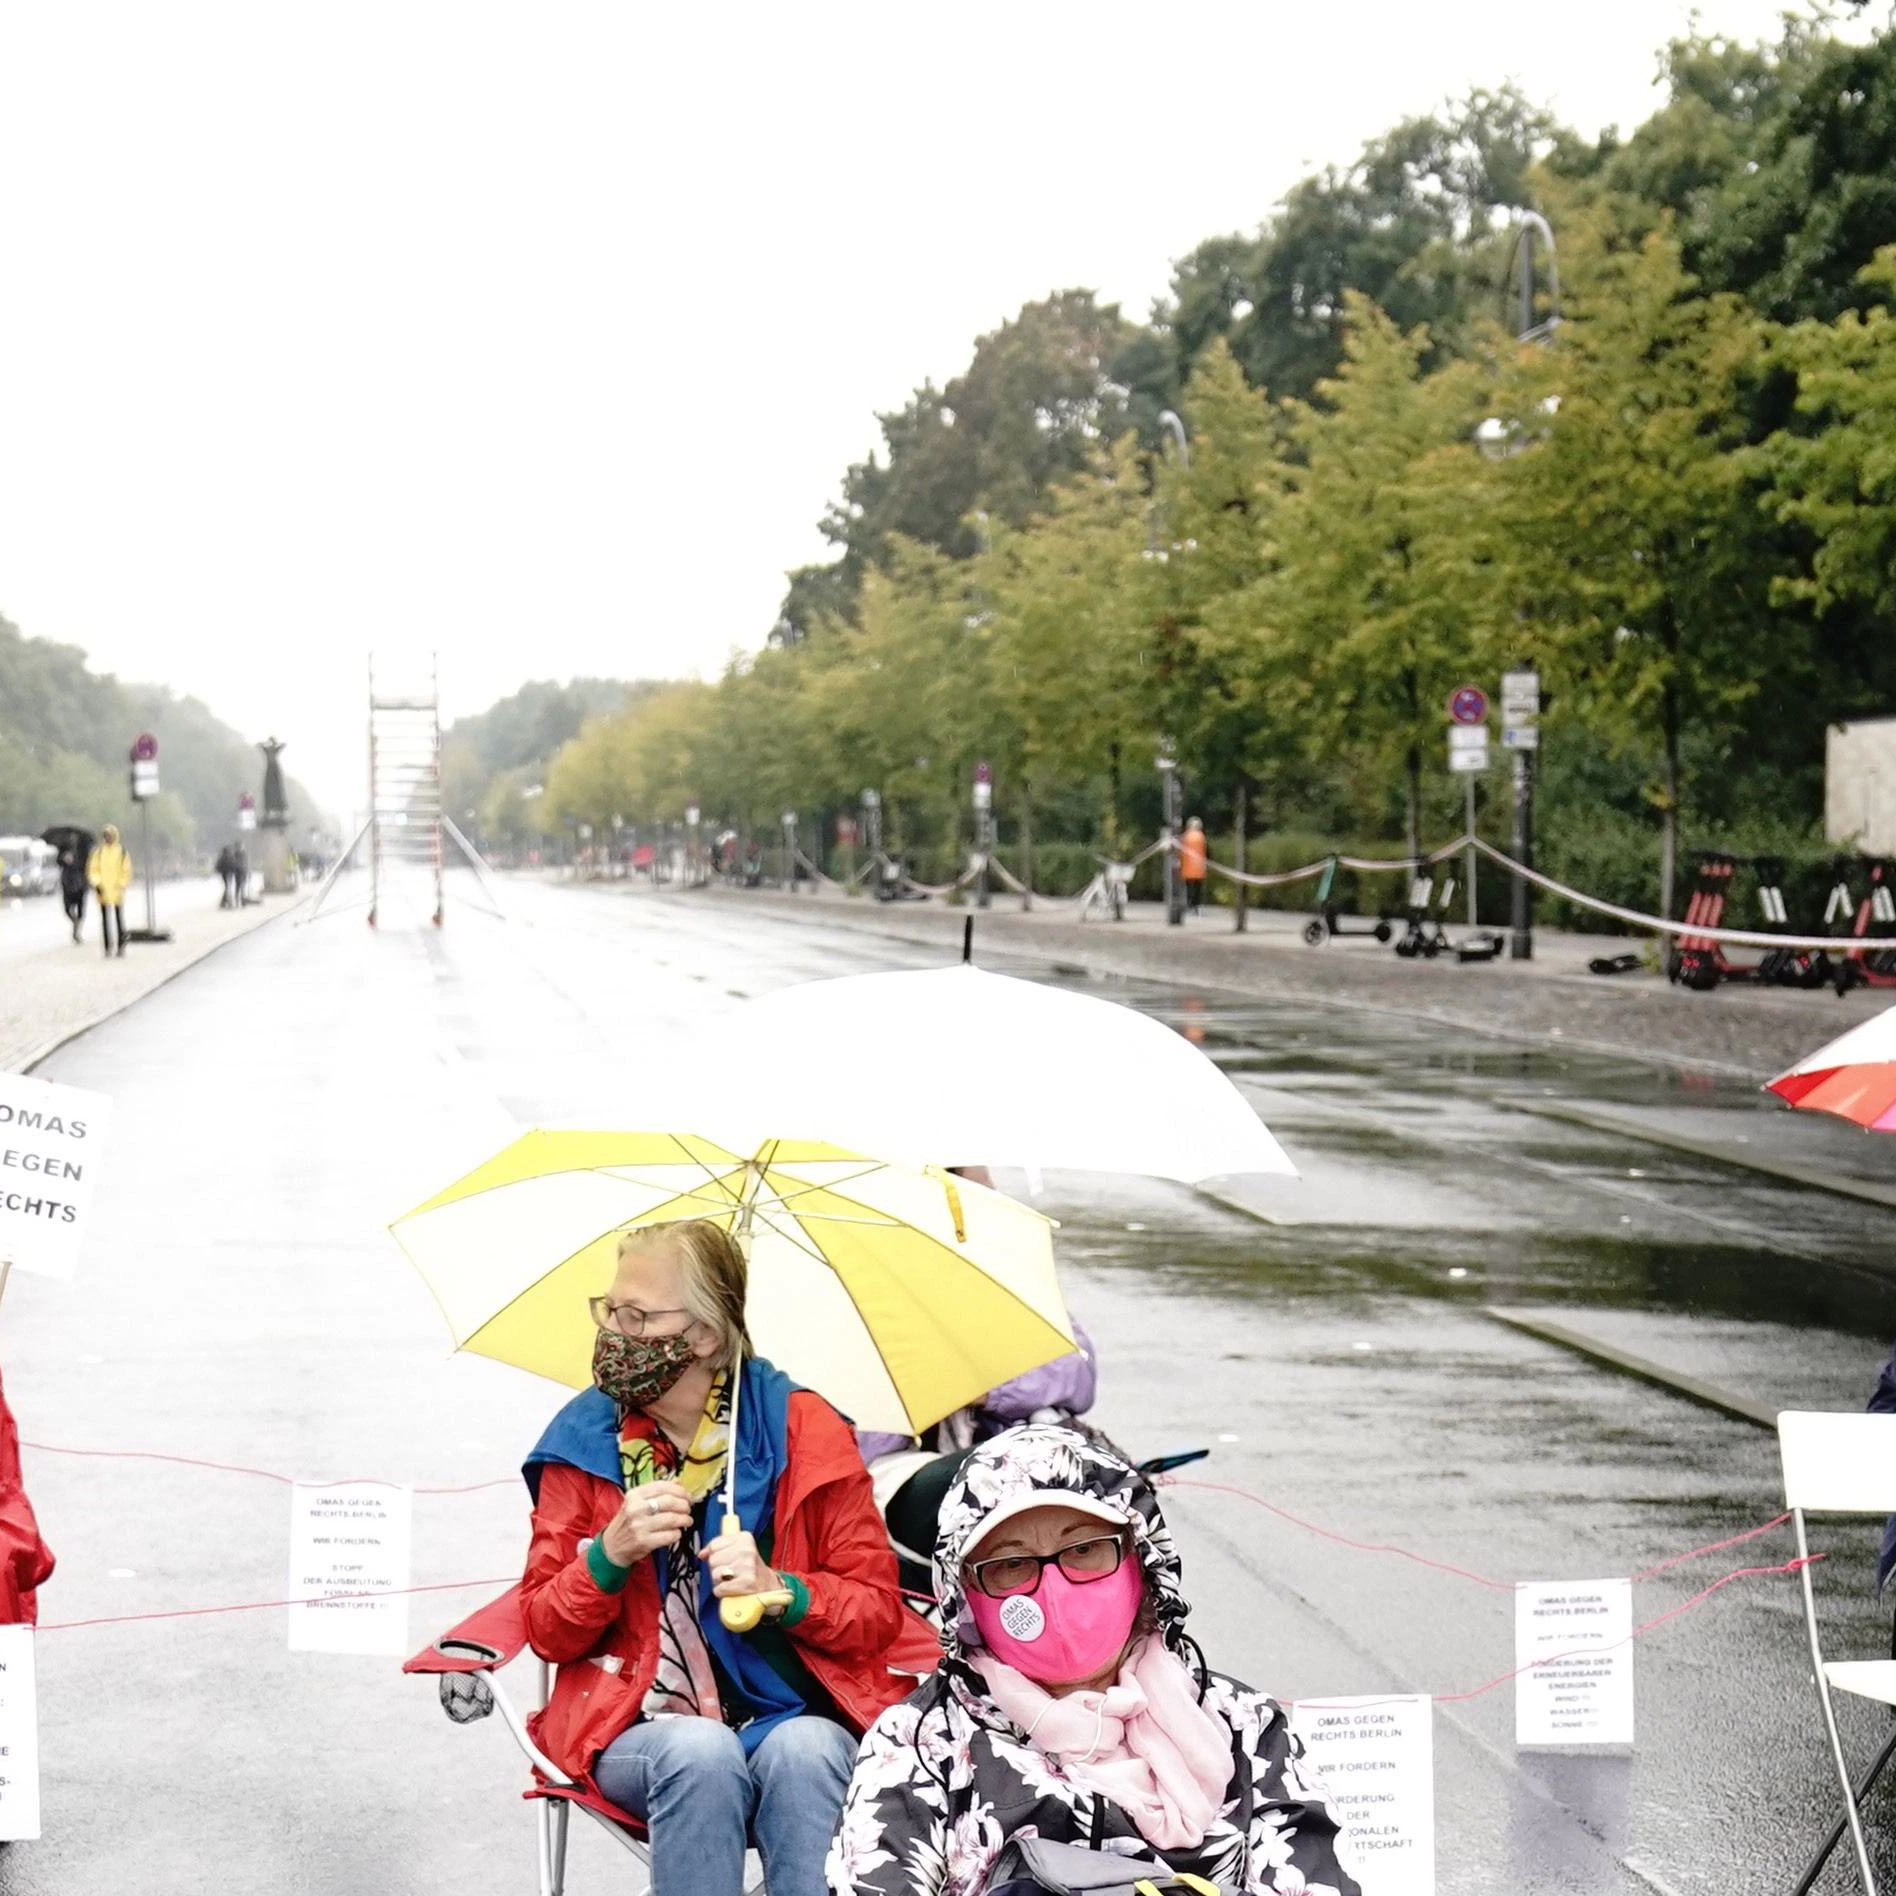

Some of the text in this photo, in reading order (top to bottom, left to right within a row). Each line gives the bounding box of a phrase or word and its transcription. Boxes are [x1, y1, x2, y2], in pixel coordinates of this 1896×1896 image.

[1002, 1599, 1024, 1620] OMAS
[1008, 1606, 1032, 1629] GEGEN
[1318, 1715, 1394, 1727] OMAS GEGEN
[1346, 1811, 1370, 1820] DER
